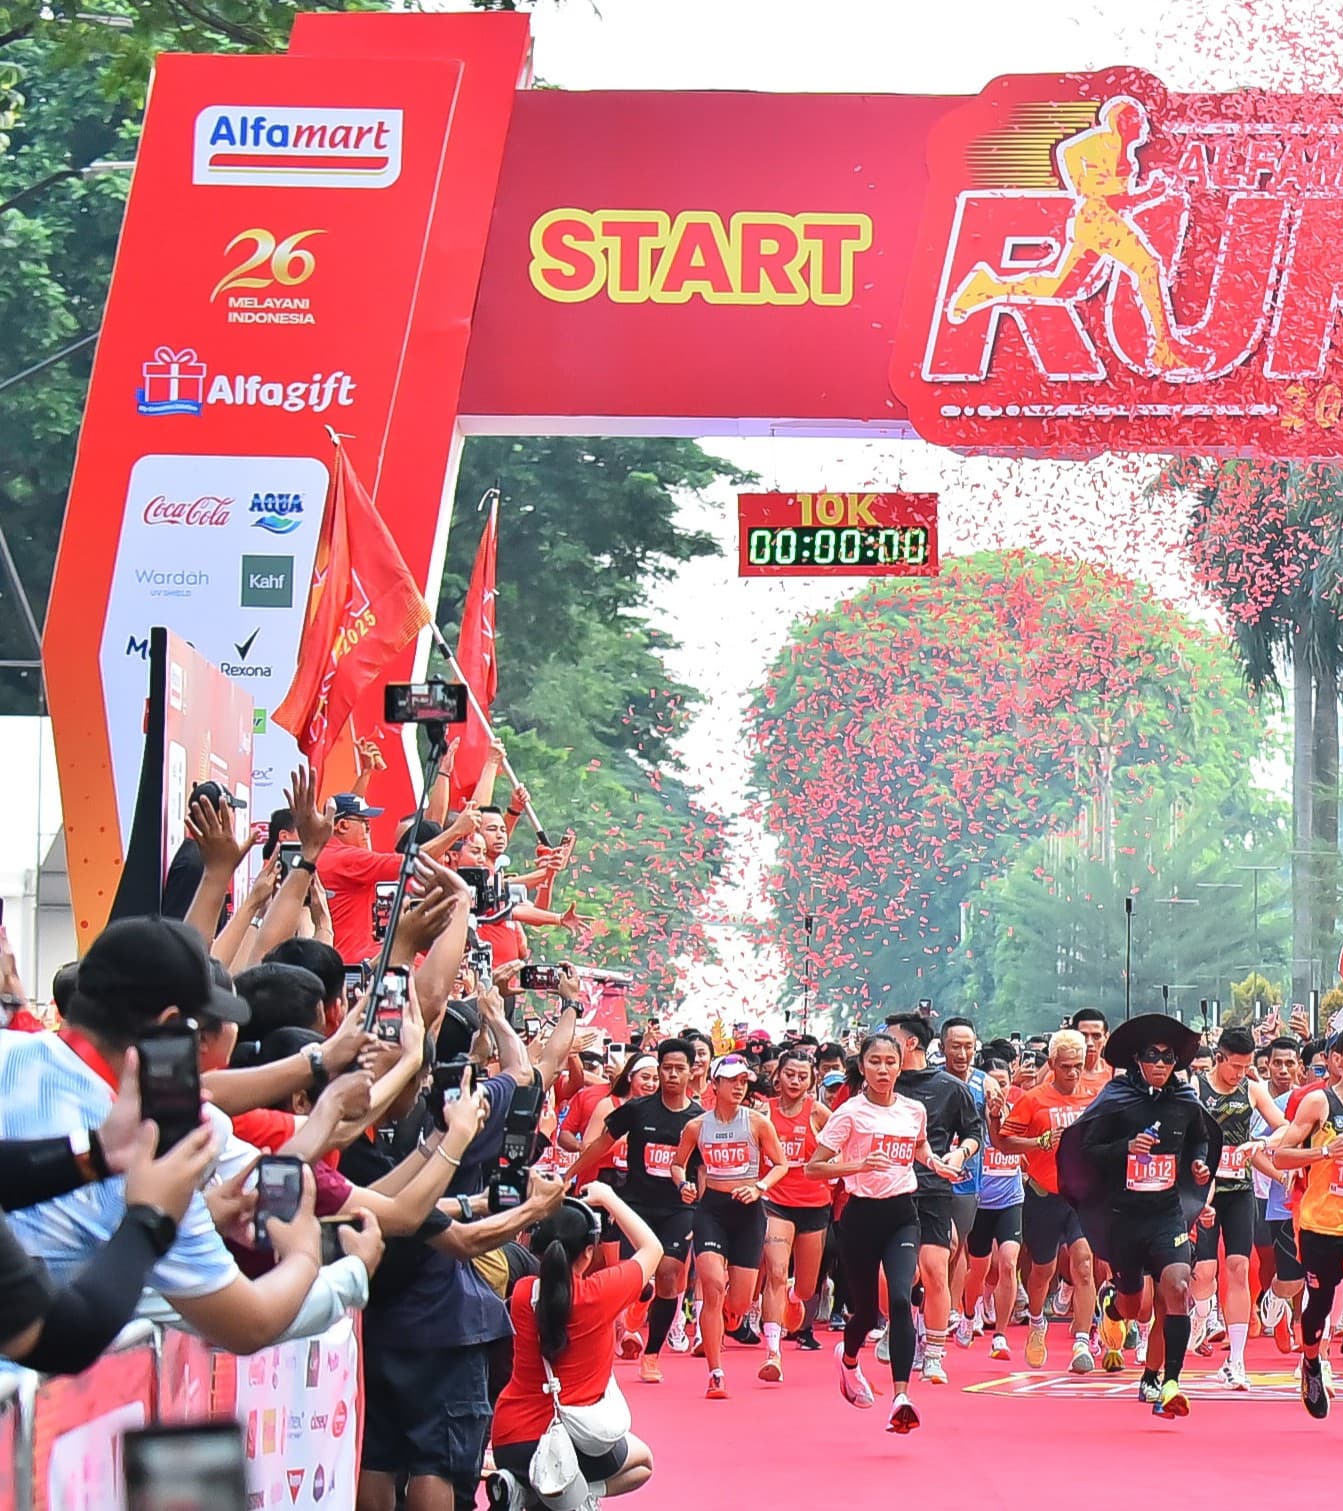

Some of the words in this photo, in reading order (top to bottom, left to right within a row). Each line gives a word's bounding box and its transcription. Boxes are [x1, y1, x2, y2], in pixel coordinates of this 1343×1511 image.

[209, 115, 391, 151] Alfamart
[210, 228, 329, 302] 26
[529, 208, 873, 306] START
[228, 296, 311, 310] MELAYANI
[227, 311, 316, 325] INDONESIA
[206, 371, 357, 413] Alfagift
[248, 492, 304, 516] AQUA
[796, 493, 881, 527] 10K
[750, 529, 926, 564] 00:00:00
[135, 569, 209, 586] Wardah
[249, 574, 285, 589] Kahf
[341, 609, 377, 656] 2025
[220, 663, 272, 677] Rexona
[708, 1148, 745, 1163] 10976
[877, 1141, 914, 1160] 11865
[1134, 1161, 1172, 1177] 11612
